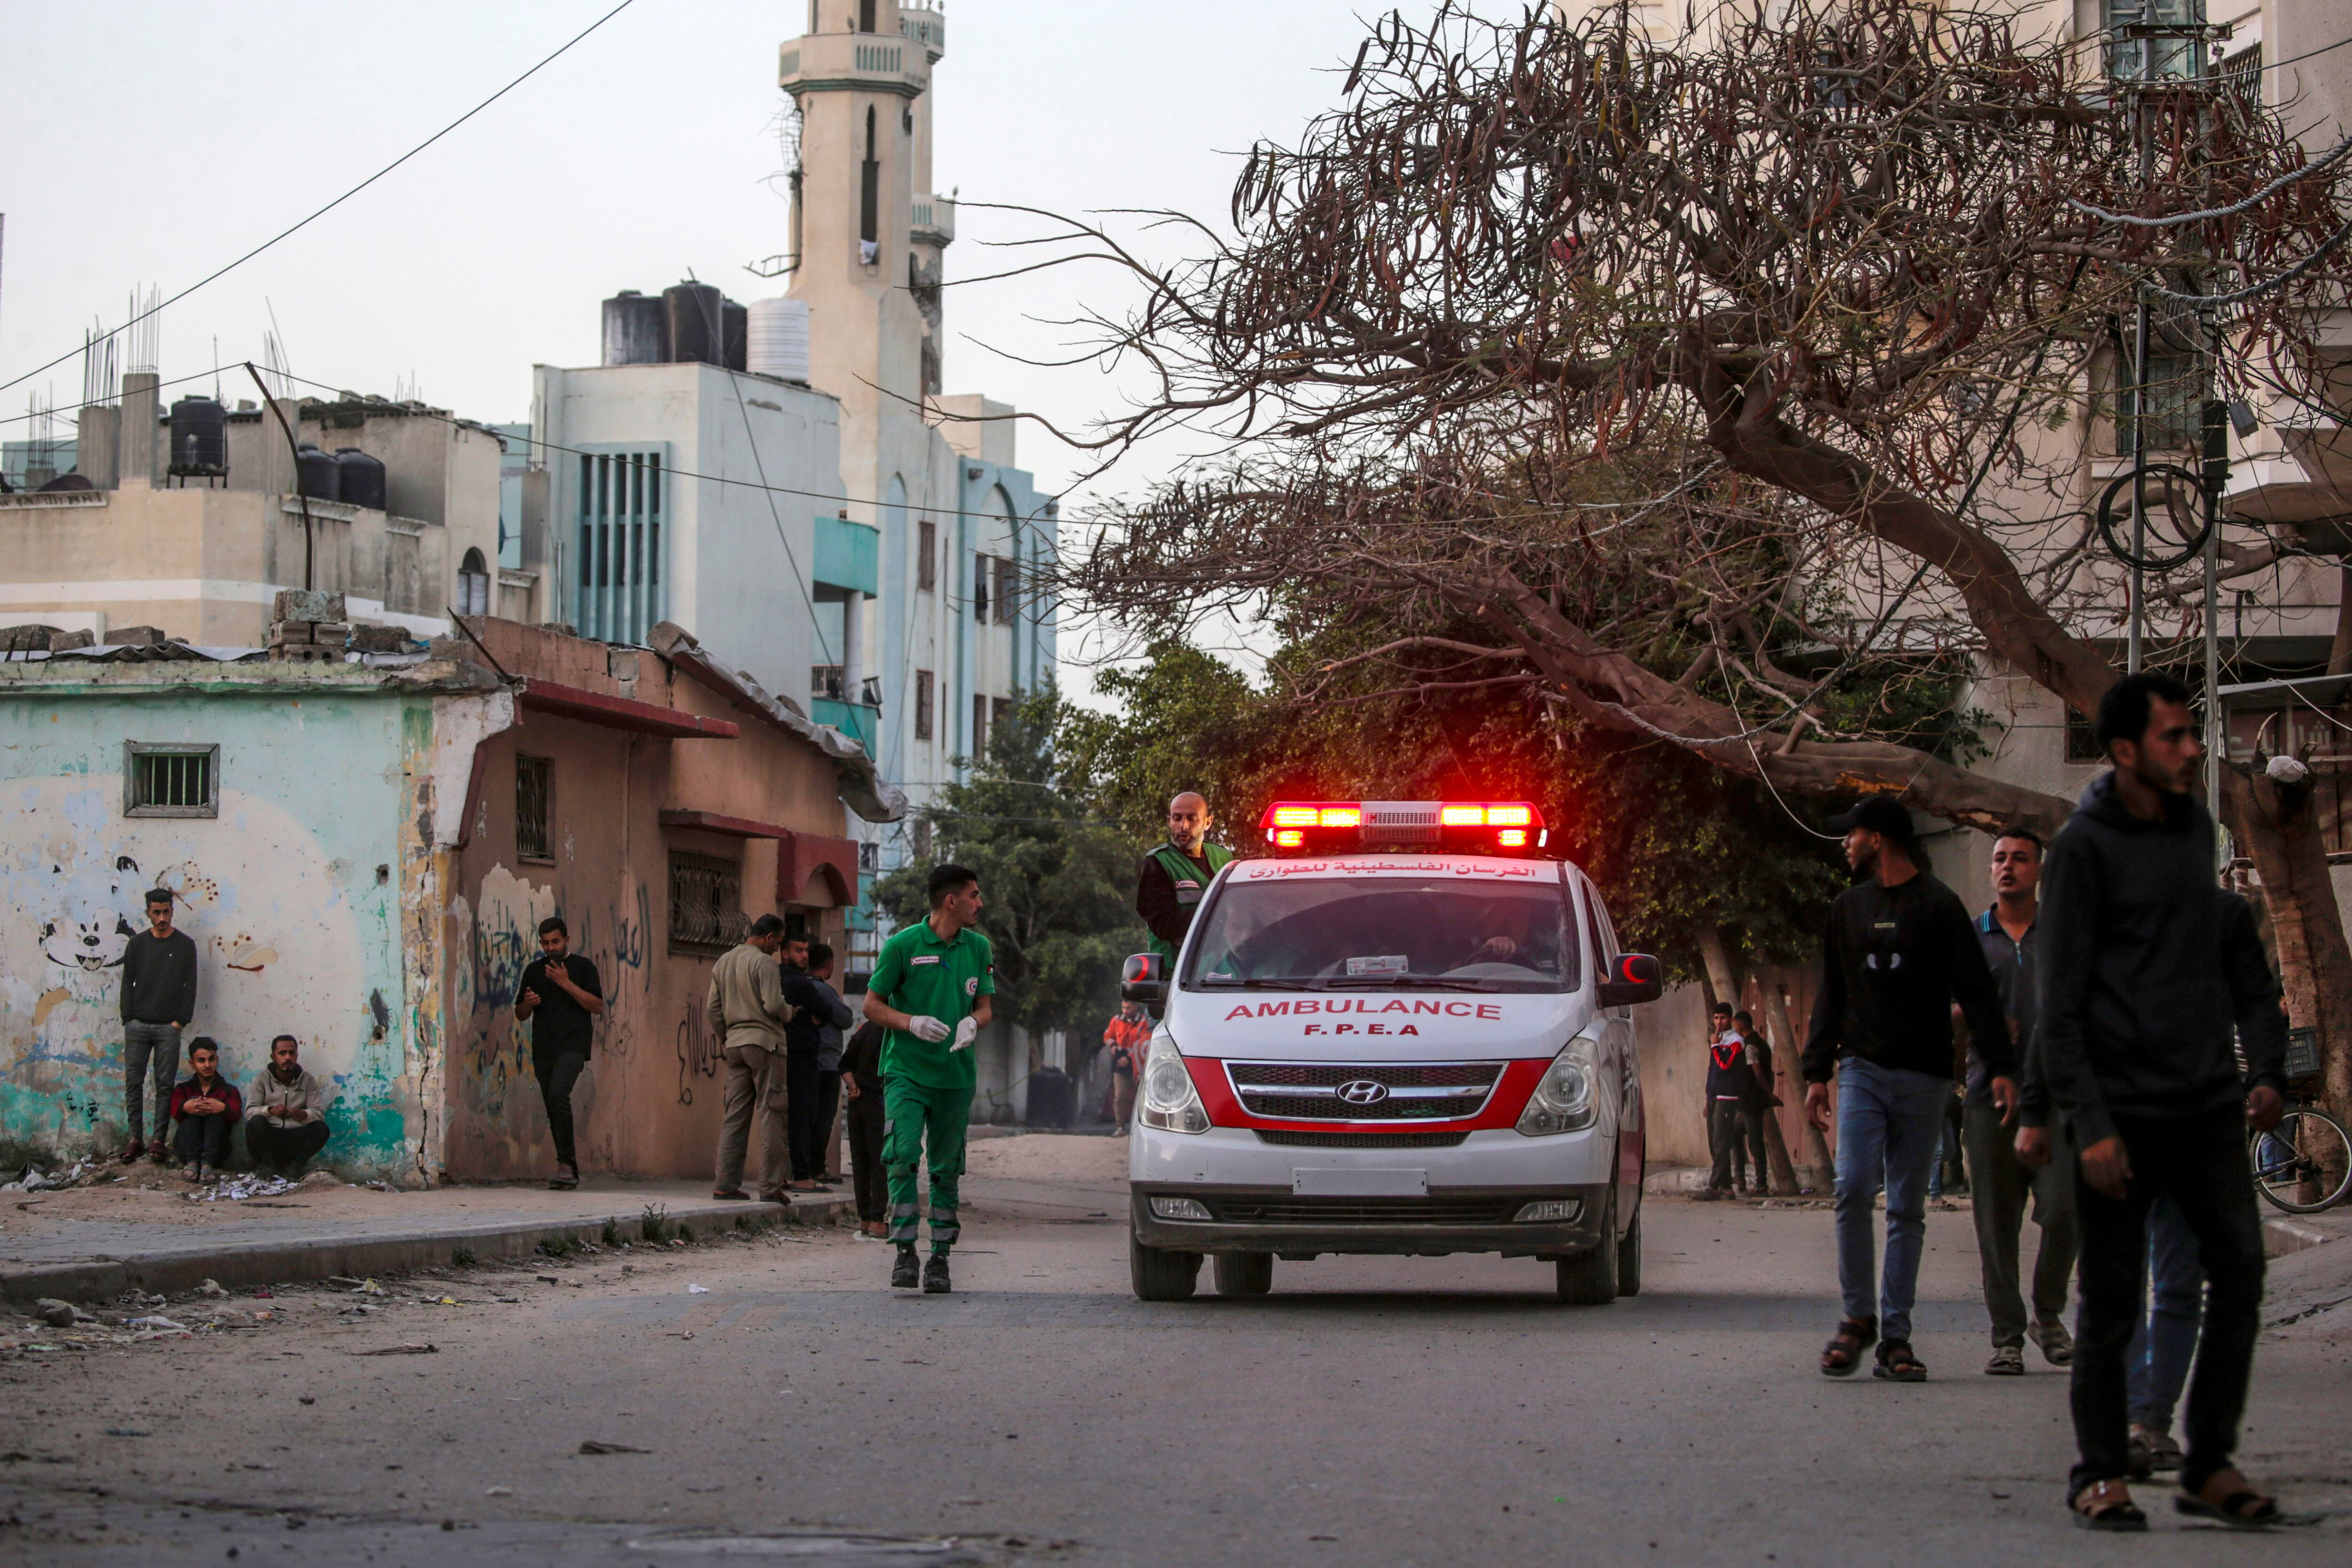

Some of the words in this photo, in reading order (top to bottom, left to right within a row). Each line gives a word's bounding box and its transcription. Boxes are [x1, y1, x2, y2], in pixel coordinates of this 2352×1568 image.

[1333, 861, 1450, 874] الفلسطينية
[1455, 864, 1536, 878] الفرسان
[1224, 999, 1502, 1021] AMBULANCE
